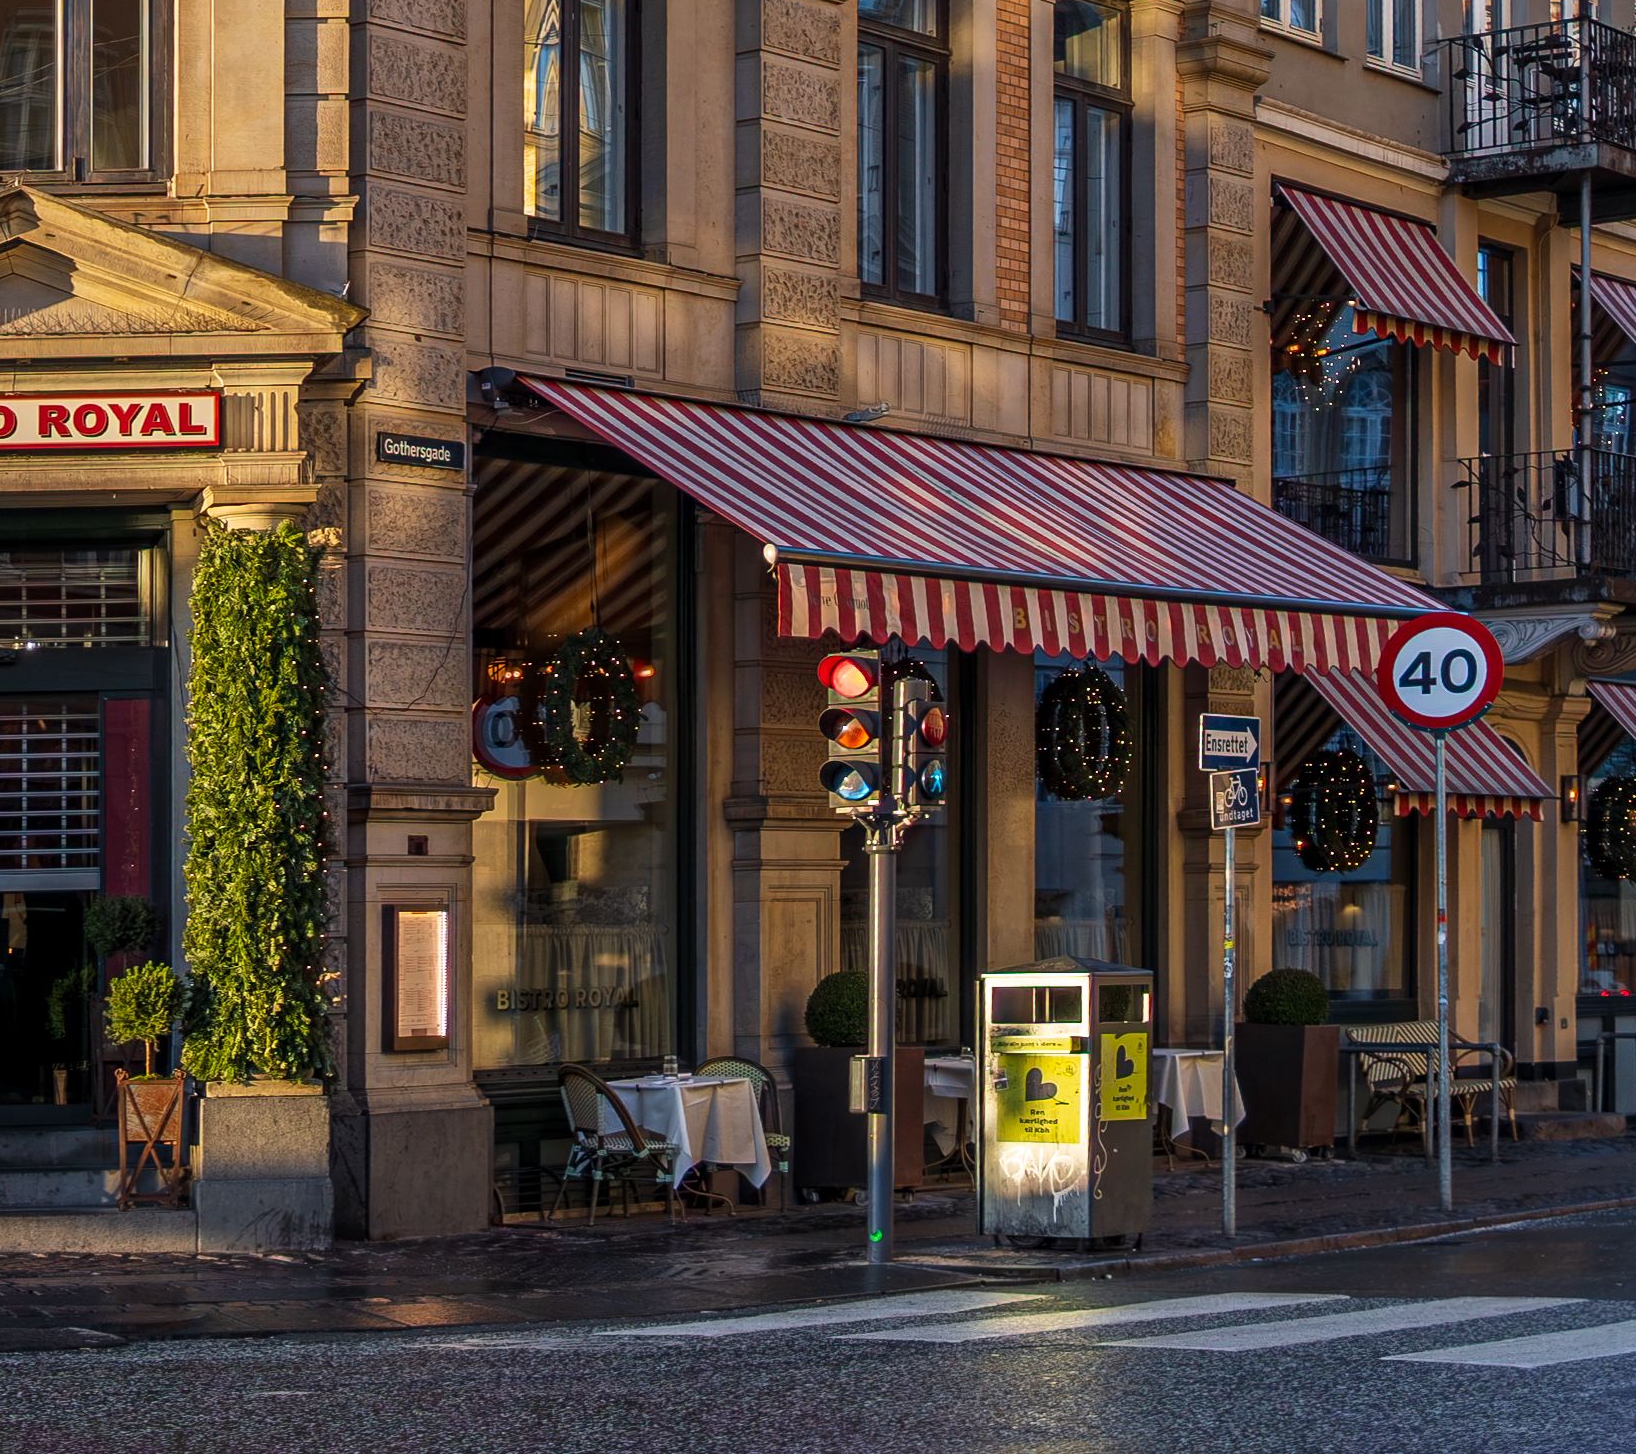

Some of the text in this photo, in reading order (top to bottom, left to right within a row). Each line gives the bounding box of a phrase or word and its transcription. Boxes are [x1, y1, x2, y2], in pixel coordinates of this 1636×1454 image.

[38, 402, 207, 437] ROYAL
[384, 438, 451, 462] Gothersgade
[1013, 607, 1303, 652] BISTRO ROYAL
[1398, 648, 1478, 695] 40
[1205, 733, 1249, 754] Ensrettet
[1219, 807, 1254, 822] undtaget
[497, 989, 570, 1011] BISTRO
